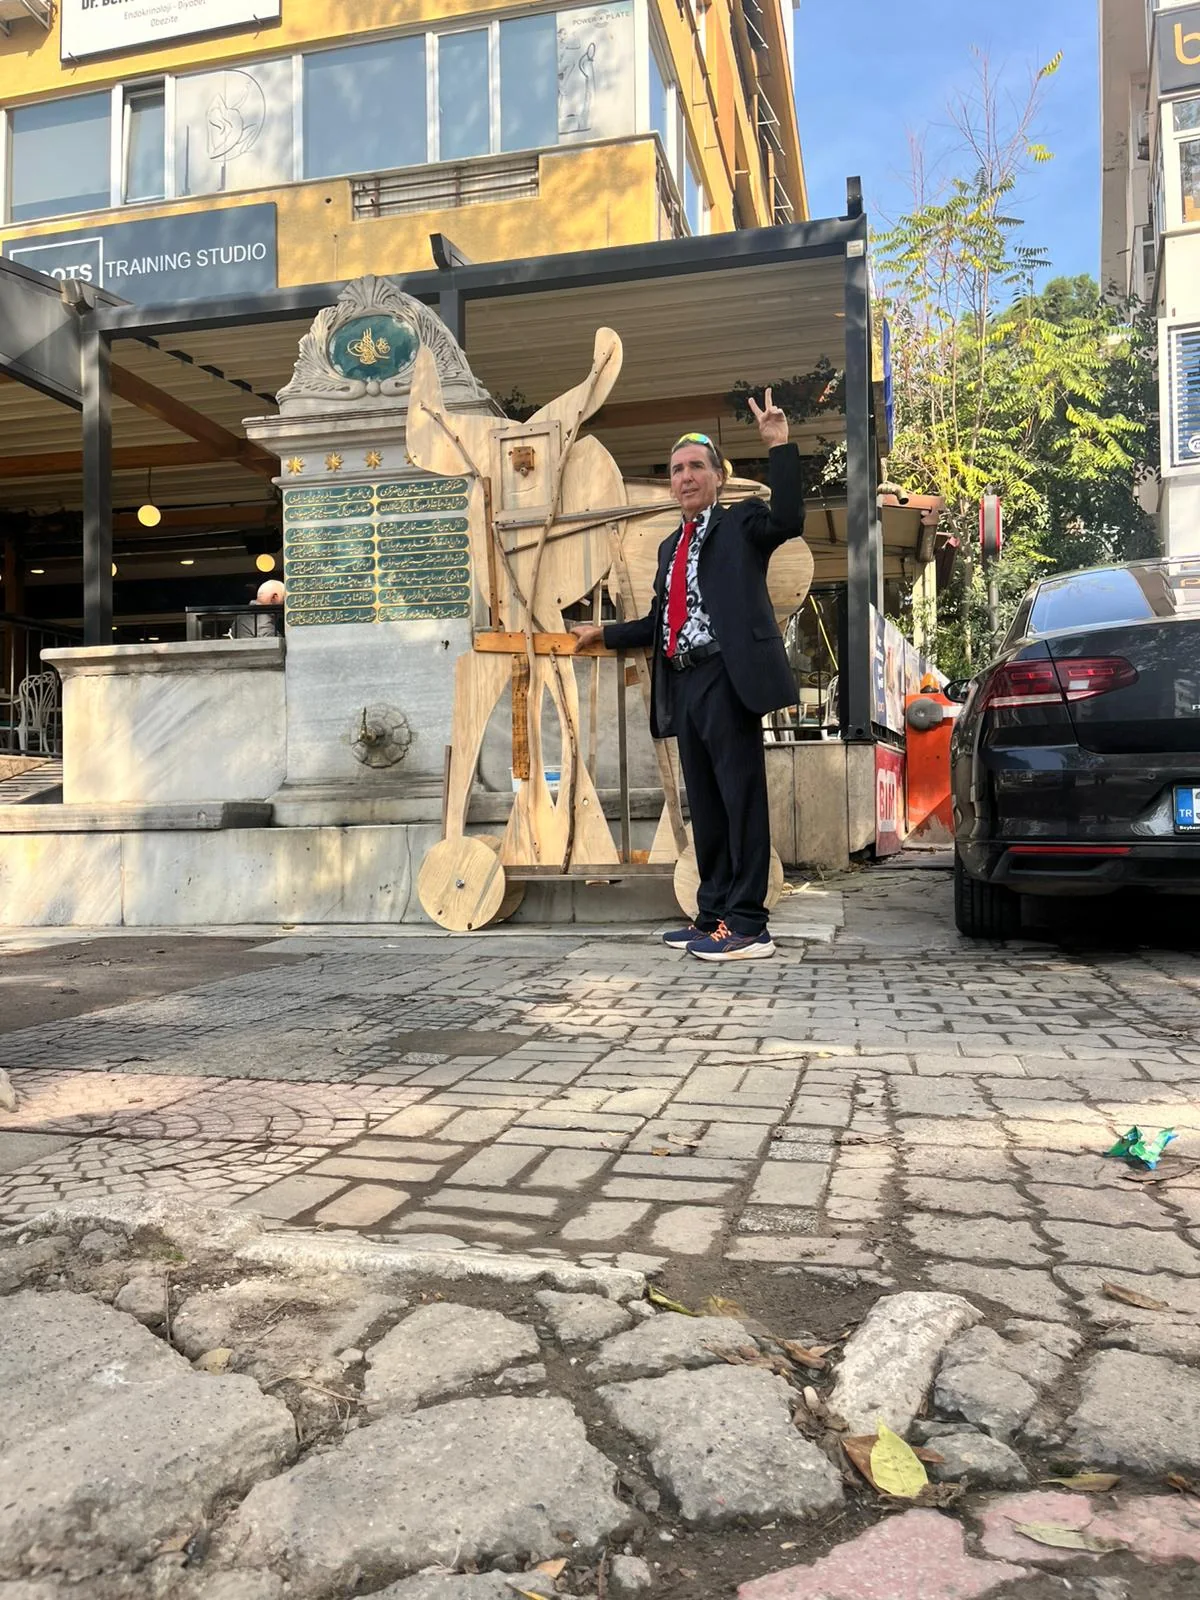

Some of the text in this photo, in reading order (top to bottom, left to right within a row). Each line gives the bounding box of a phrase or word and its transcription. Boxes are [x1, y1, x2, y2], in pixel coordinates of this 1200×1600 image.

[39, 242, 267, 282] OTS TRAINING STUDIO
[1179, 808, 1193, 818] TR
